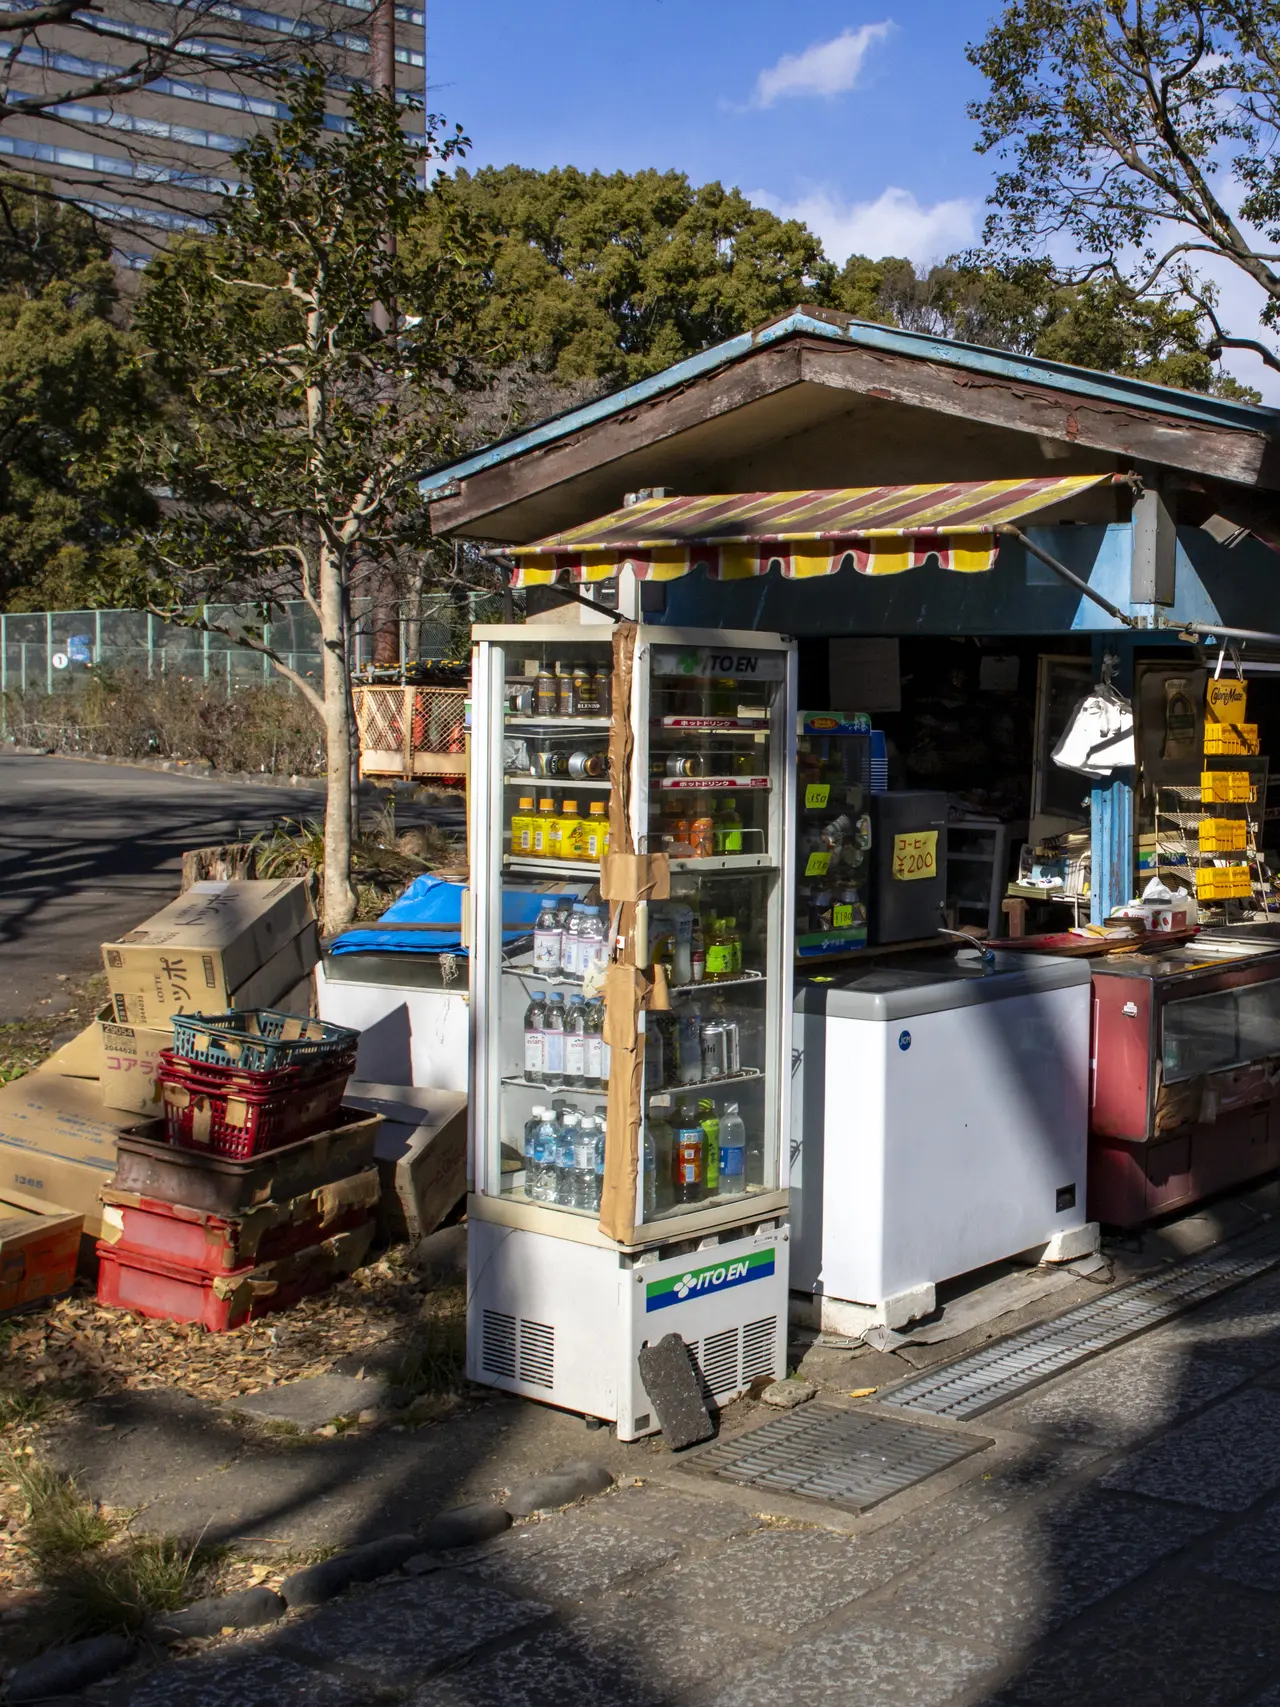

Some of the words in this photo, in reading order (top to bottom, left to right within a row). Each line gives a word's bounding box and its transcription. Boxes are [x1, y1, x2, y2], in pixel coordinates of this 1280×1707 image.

[898, 838, 928, 851] コーヒー
[895, 851, 934, 876] ¥200
[174, 893, 240, 926] トッポ
[106, 1056, 158, 1075] コアラ
[695, 1267, 726, 1291] ITO
[726, 1260, 750, 1282] EN
